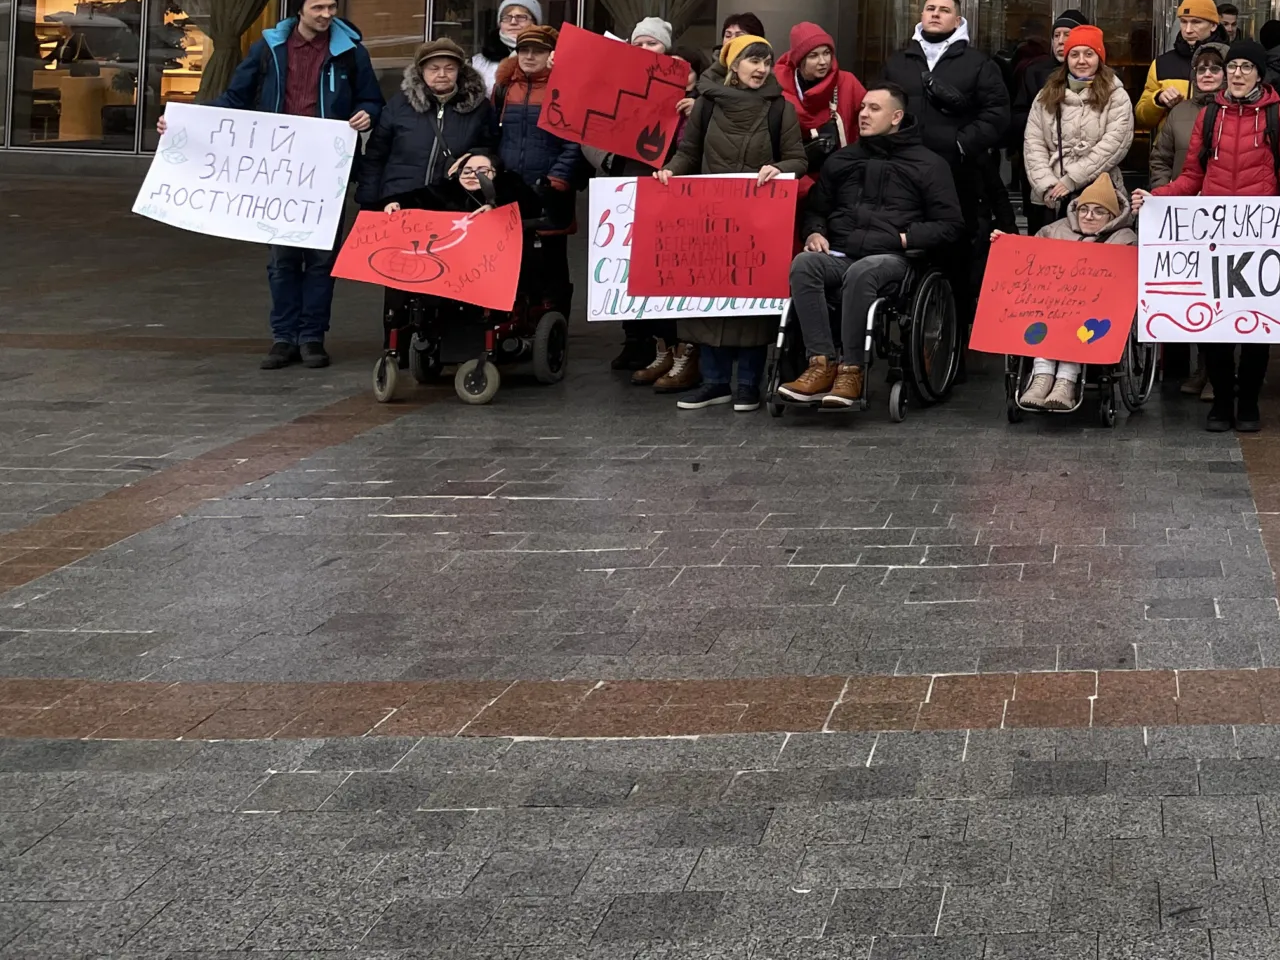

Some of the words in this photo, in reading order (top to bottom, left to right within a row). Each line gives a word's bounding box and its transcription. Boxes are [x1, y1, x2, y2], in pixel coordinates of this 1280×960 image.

[210, 119, 297, 154] ДІЙ
[198, 152, 316, 189] ЗАРАДИ
[149, 183, 325, 225] ДОСТУПНОСТІ
[1158, 204, 1227, 242] ЛЕСЯ
[656, 269, 676, 287] ЗА
[686, 266, 757, 287] ЗАХИСТ
[1153, 250, 1200, 279] МОЯ
